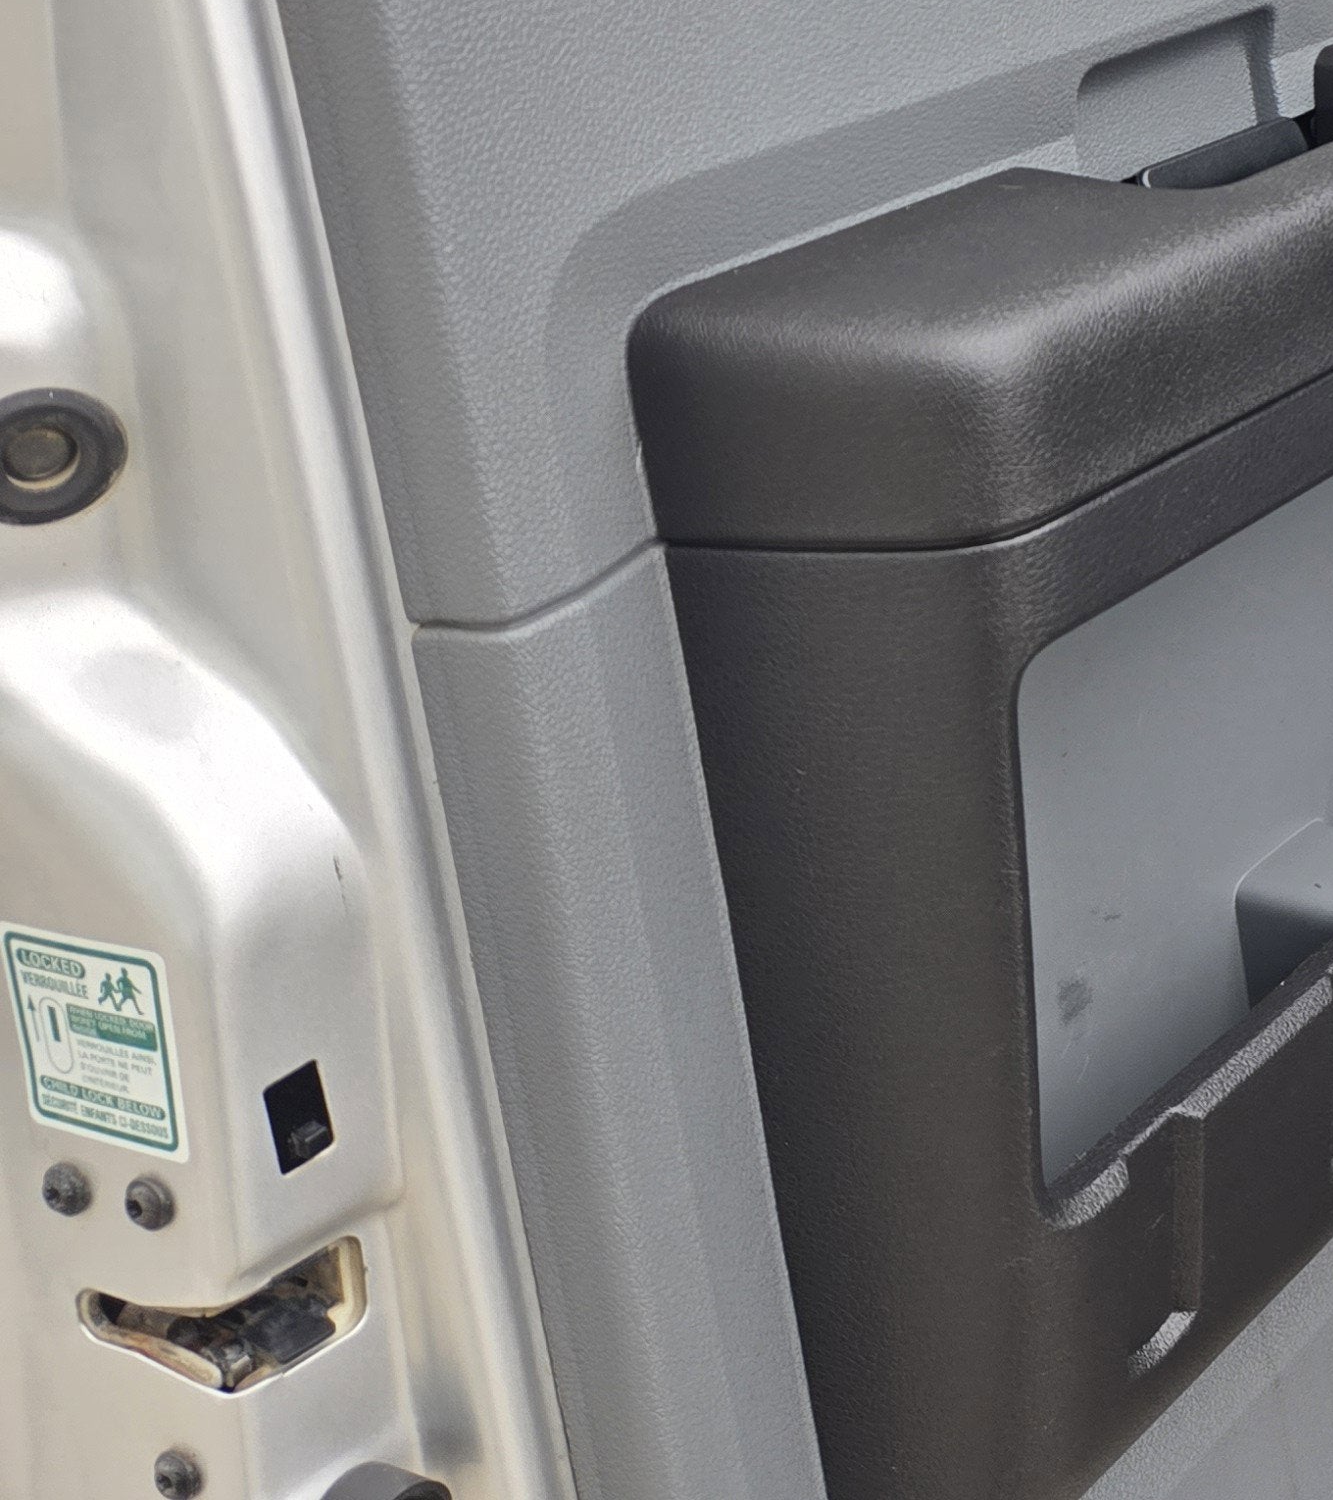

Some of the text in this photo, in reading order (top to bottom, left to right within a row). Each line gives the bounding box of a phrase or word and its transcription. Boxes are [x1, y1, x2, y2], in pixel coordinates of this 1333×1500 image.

[21, 950, 82, 977] LOCKED
[43, 1076, 162, 1119] CHILD LOCK BELOW
